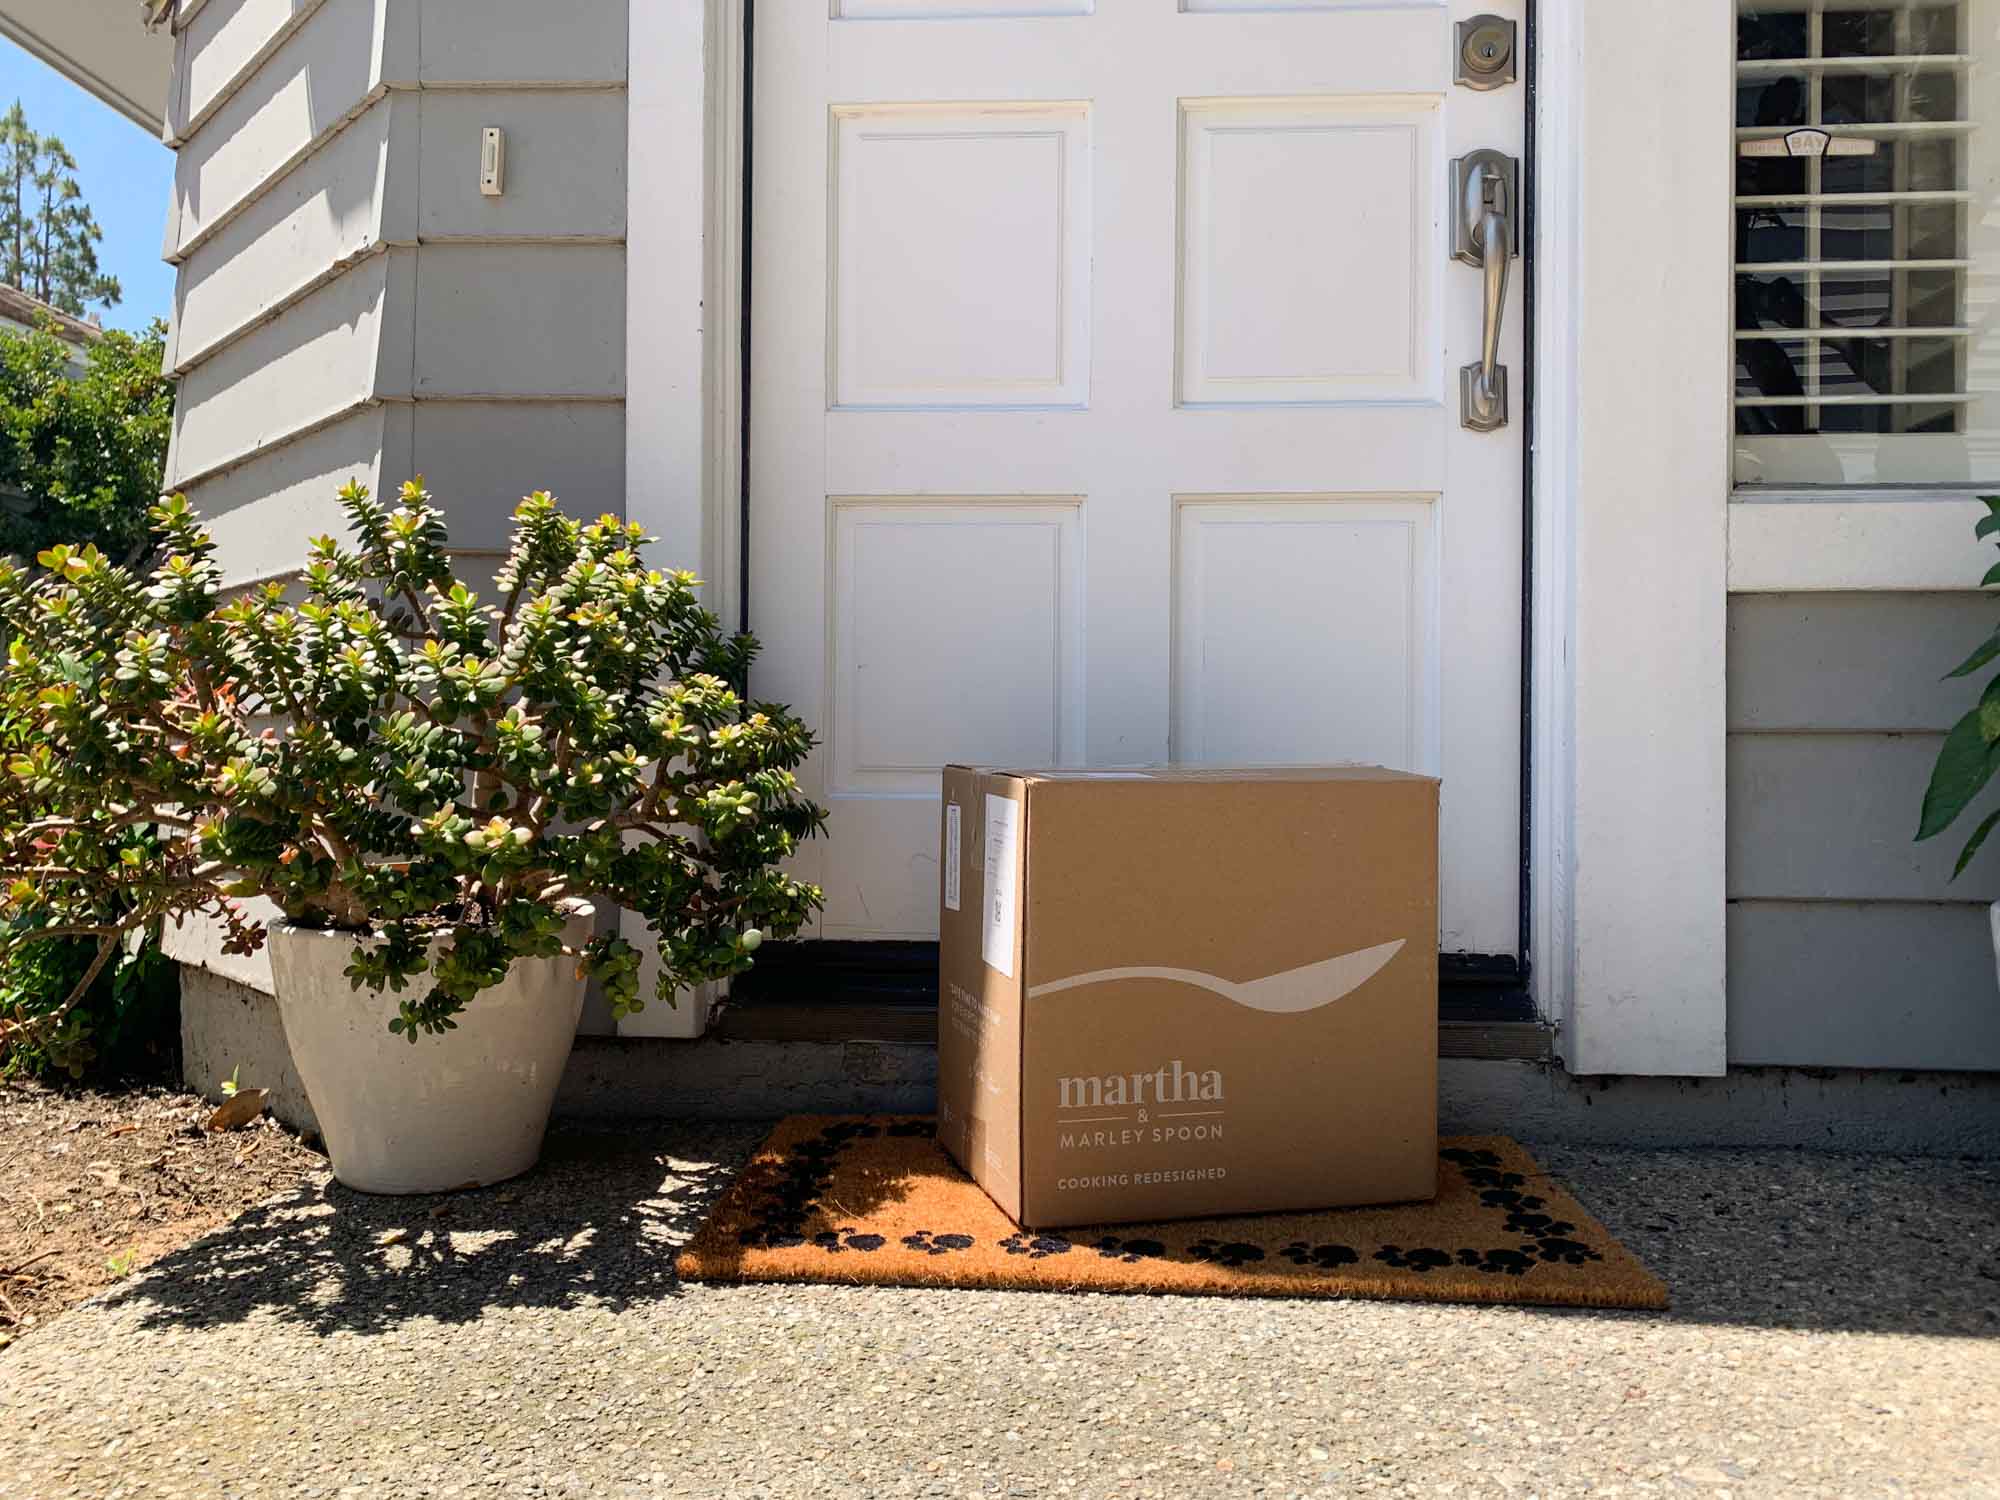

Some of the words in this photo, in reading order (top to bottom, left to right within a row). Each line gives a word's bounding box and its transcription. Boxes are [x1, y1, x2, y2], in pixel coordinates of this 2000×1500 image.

[1057, 1059, 1225, 1108] martha
[1137, 1108, 1149, 1123] &
[1060, 1128, 1144, 1149] MARLEY
[1152, 1124, 1223, 1142] SPOON
[1057, 1174, 1129, 1190] COOKING
[1134, 1168, 1226, 1185] REDESIGNED
